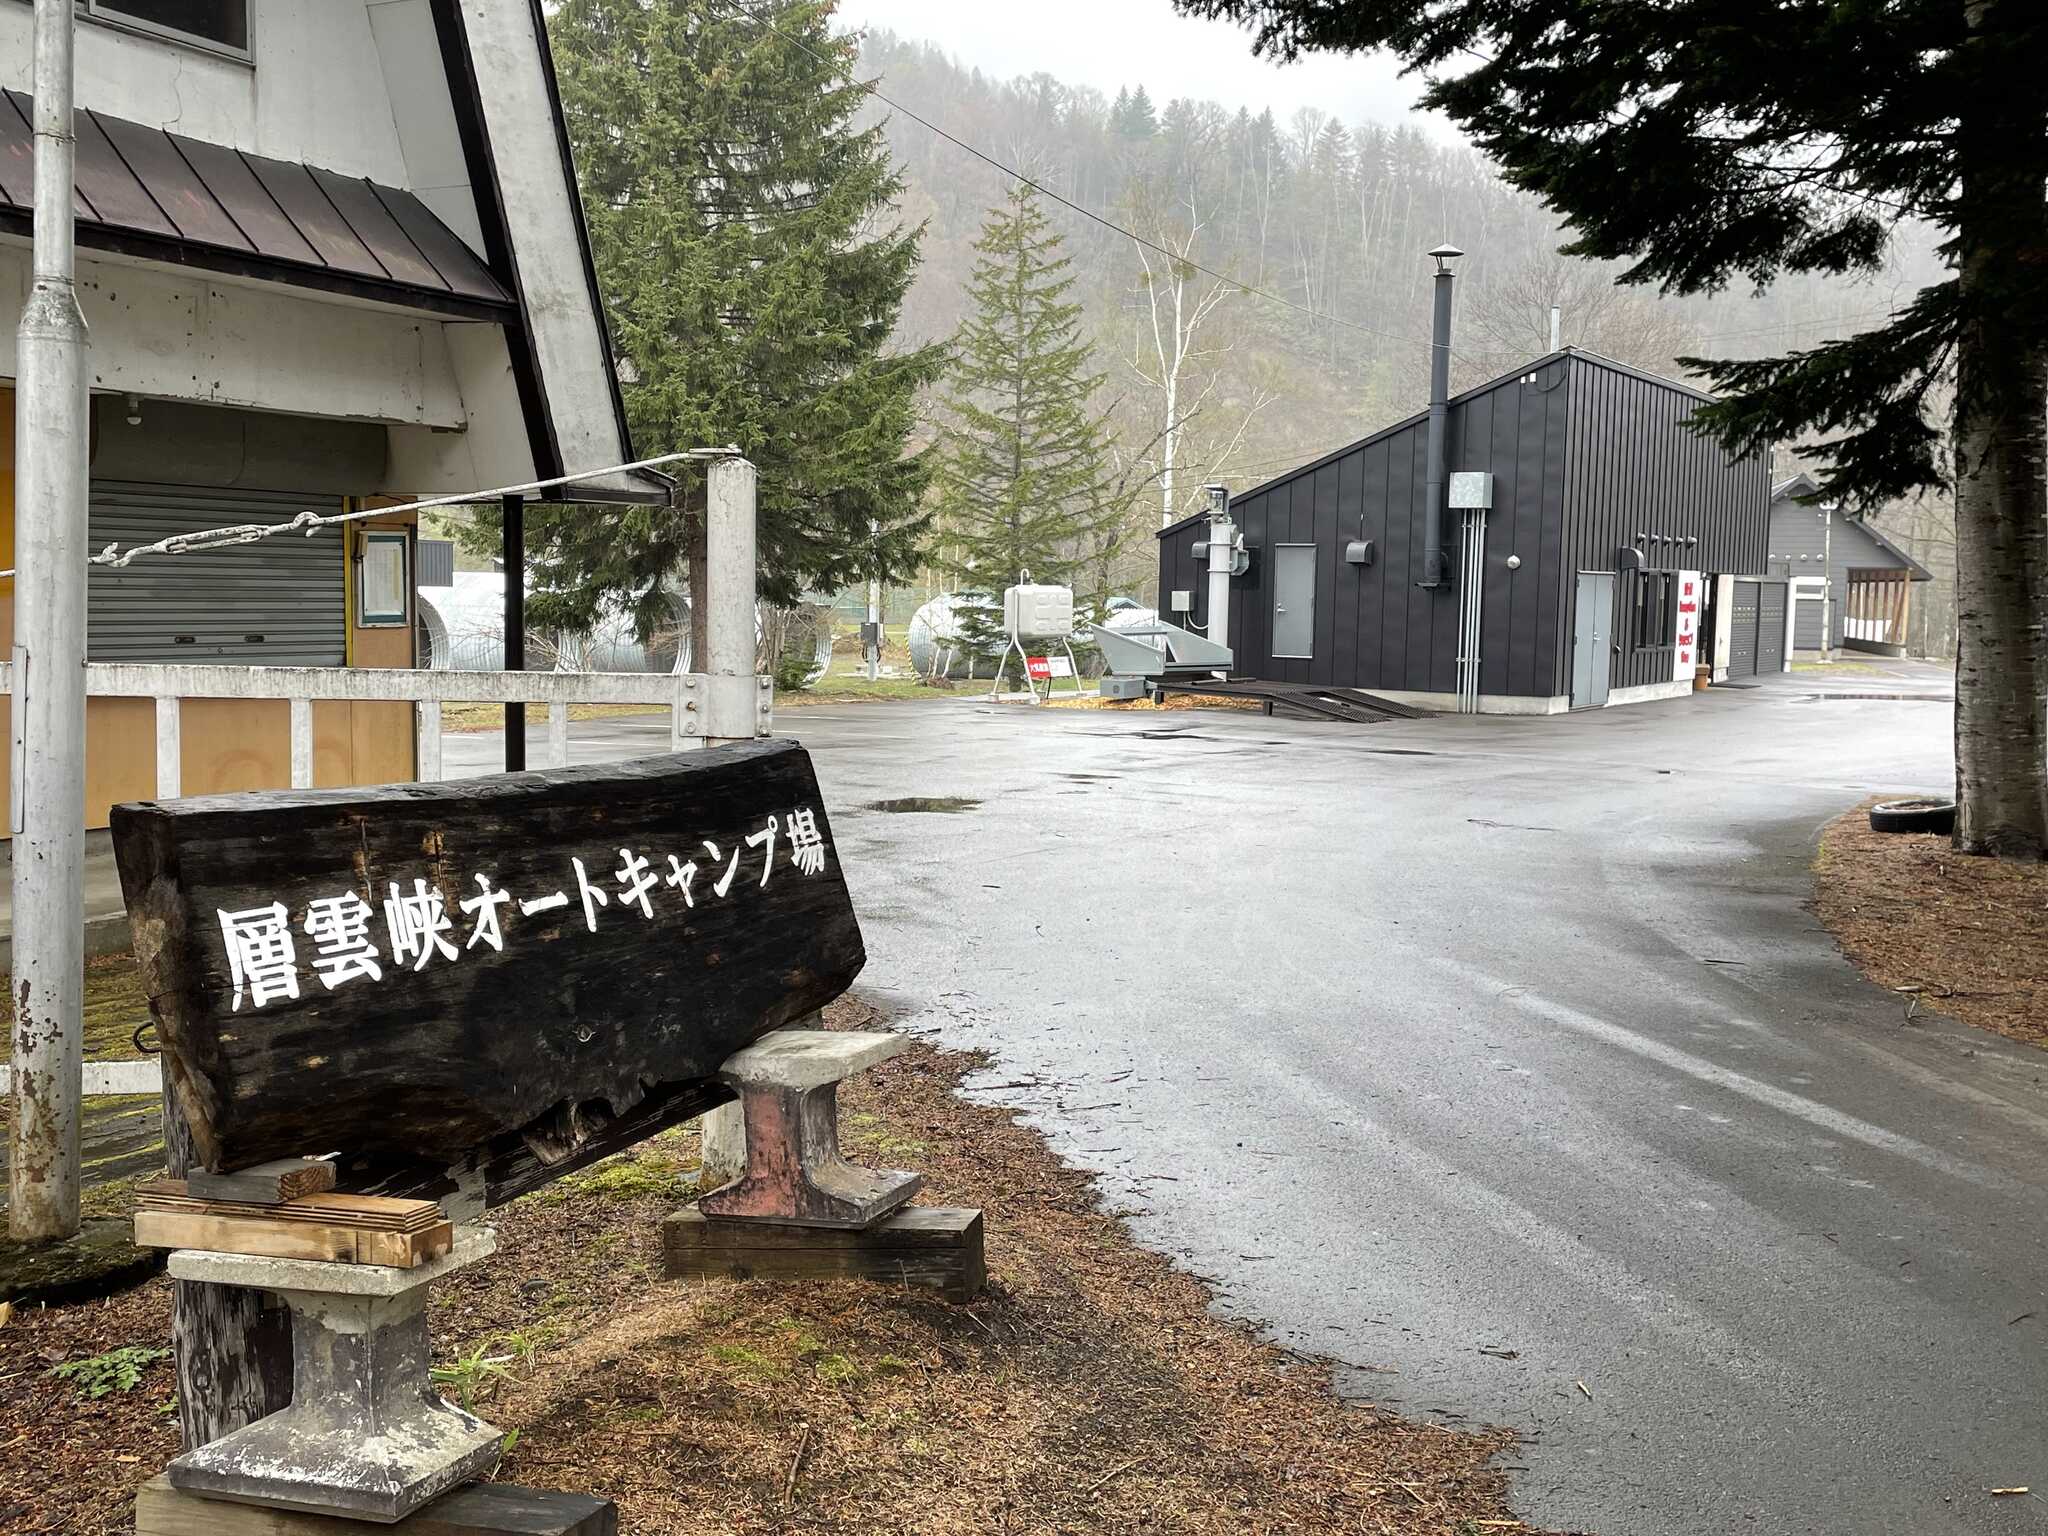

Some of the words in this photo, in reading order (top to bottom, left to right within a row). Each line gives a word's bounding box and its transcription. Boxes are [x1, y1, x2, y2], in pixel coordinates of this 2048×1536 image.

[216, 807, 825, 1011] 層雲峡オートキャンプ場
